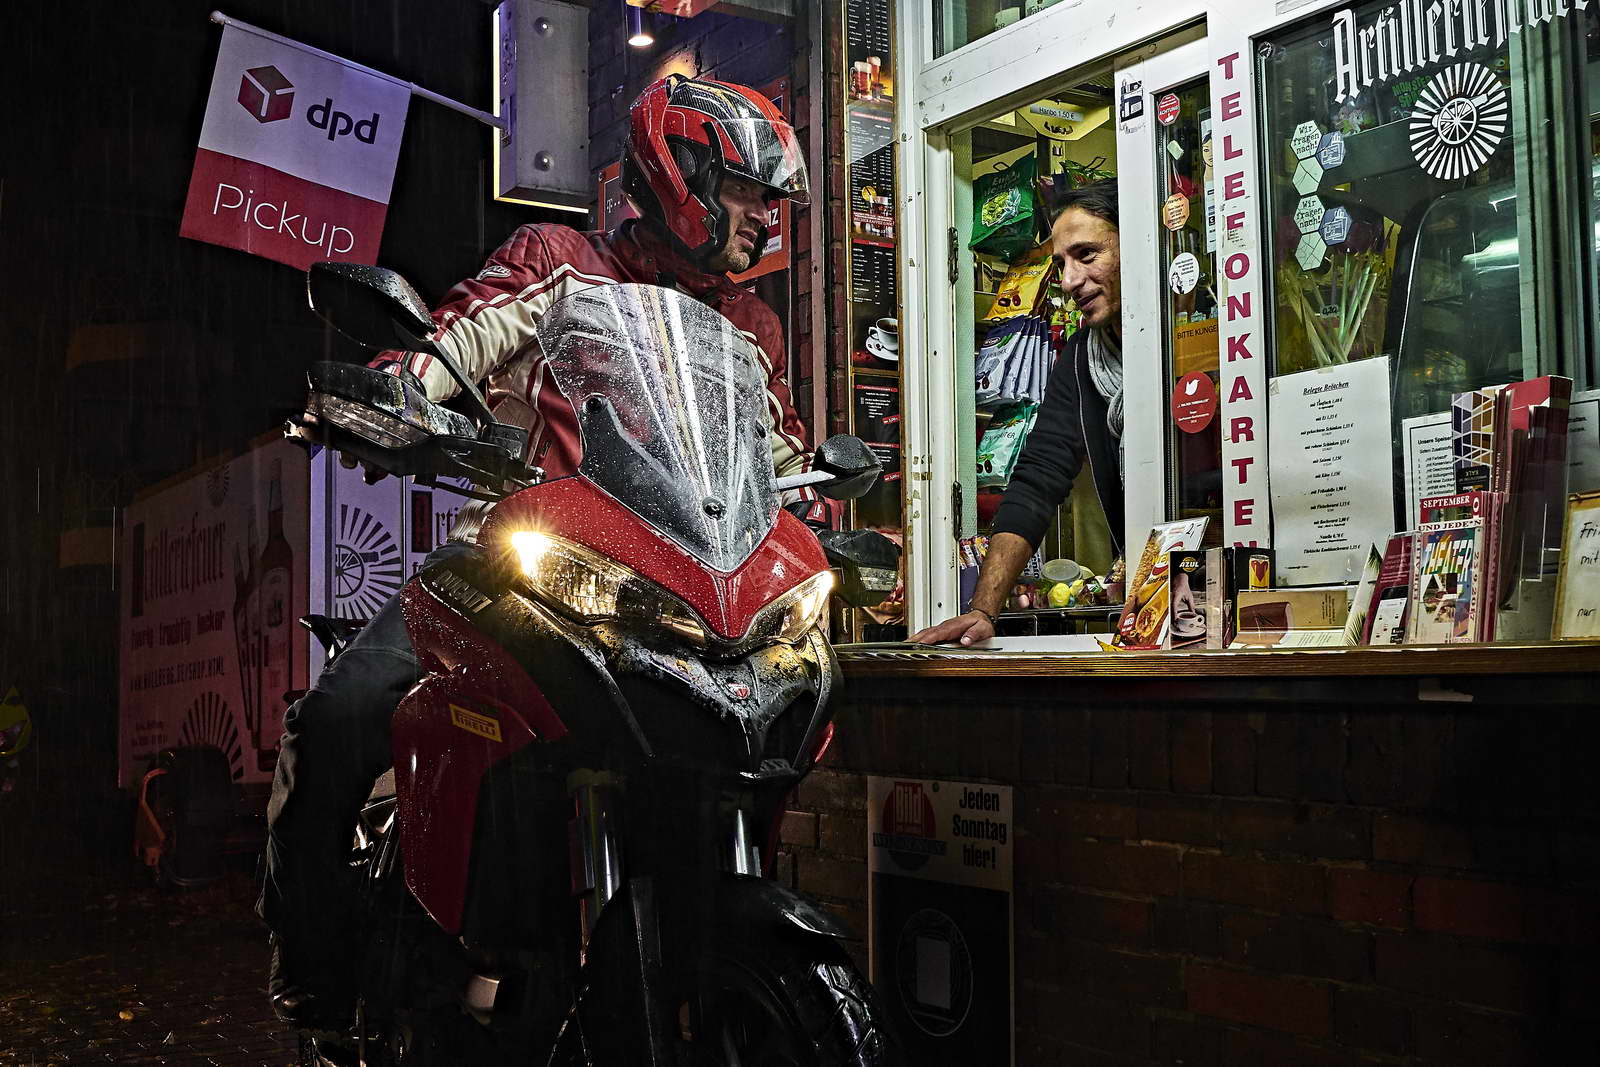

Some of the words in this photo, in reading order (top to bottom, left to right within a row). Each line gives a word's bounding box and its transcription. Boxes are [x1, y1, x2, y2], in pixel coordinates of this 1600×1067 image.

[306, 98, 380, 144] dpd
[1299, 124, 1313, 134] Wir
[1294, 133, 1320, 145] fragen
[1296, 141, 1318, 154] nach!
[1302, 199, 1316, 208] Wir
[212, 183, 355, 258] Pickup
[1296, 208, 1323, 220] fragen
[1299, 216, 1321, 228] nach!
[1217, 51, 1258, 549] TELEFONKARTE
[1177, 329, 1194, 339] BITTE
[1423, 495, 1470, 508] SEPTEMBER
[1418, 524, 1441, 532] UND
[1580, 521, 1600, 538] Fri
[1577, 608, 1597, 617] nur
[455, 711, 496, 737] PIRELLI
[959, 787, 1000, 811] Jeden
[953, 814, 1007, 845] Sonntag
[963, 843, 996, 869] hier!
